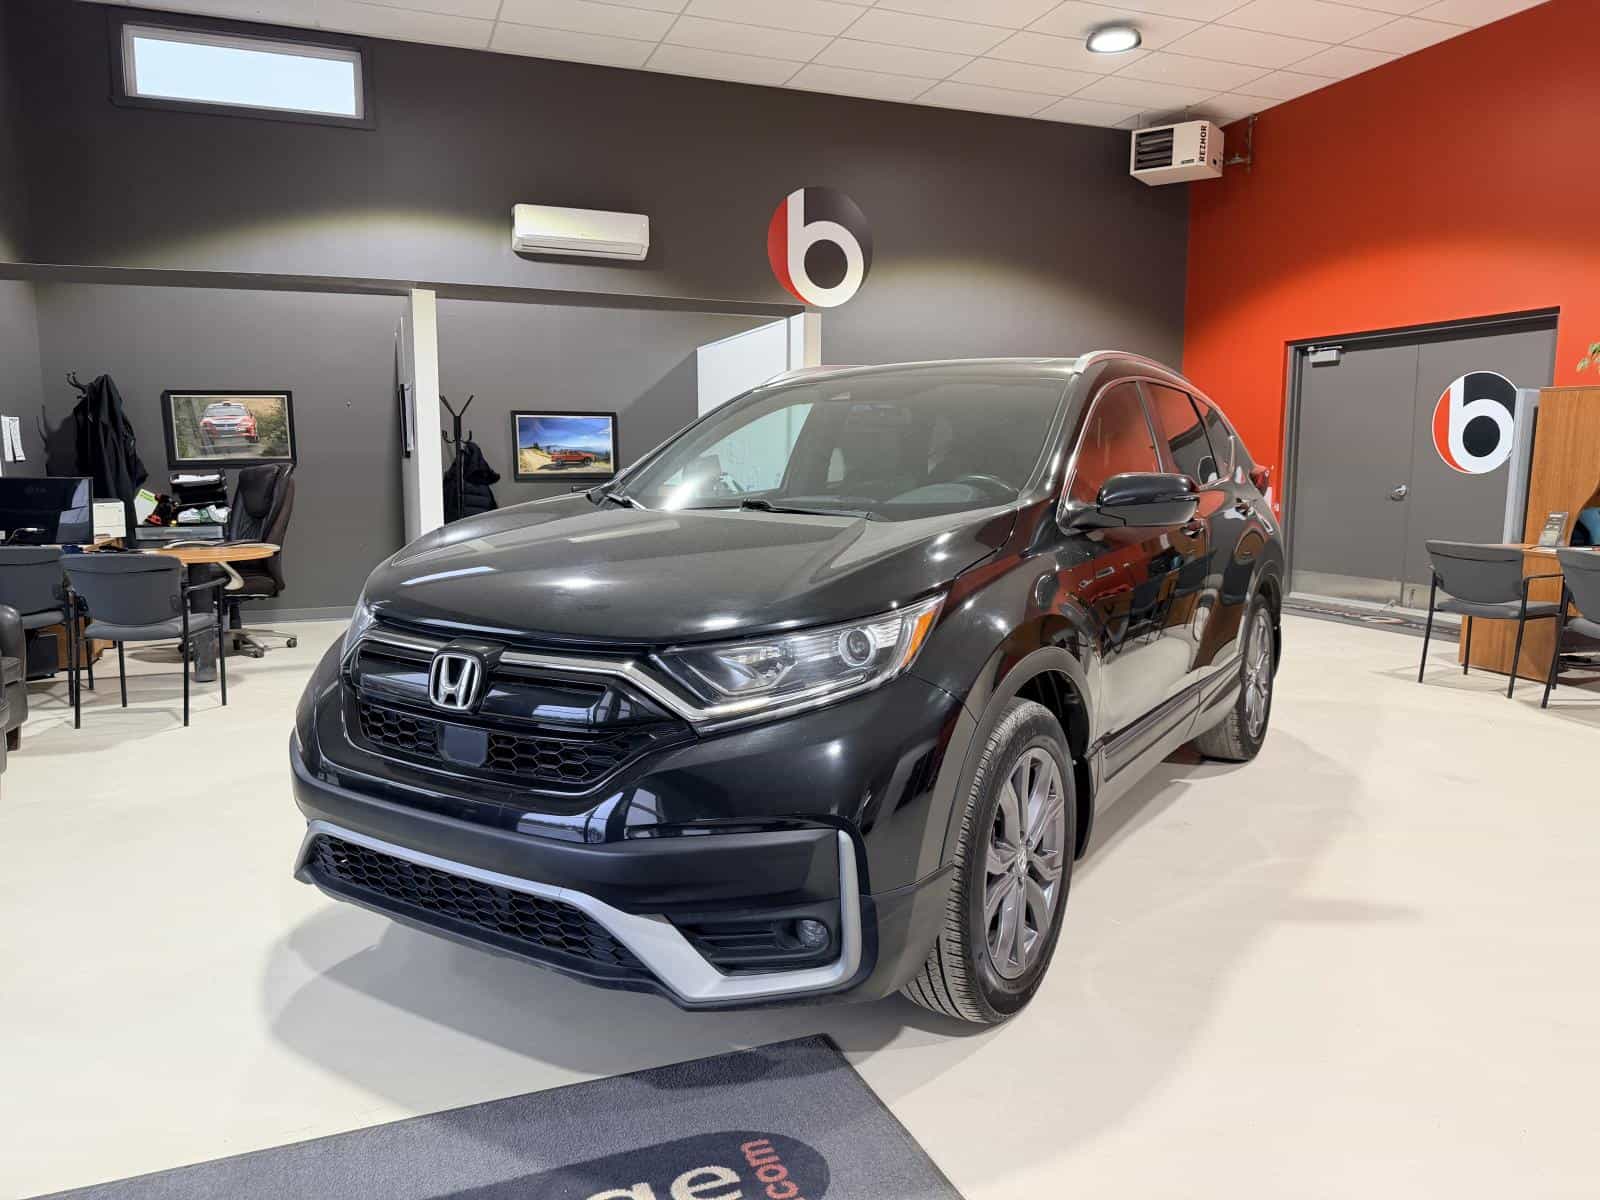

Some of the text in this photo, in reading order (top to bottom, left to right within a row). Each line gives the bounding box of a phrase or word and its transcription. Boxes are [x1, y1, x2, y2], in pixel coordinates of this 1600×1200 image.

[1199, 124, 1207, 162] REZNOR
[787, 187, 864, 308] b
[1448, 376, 1514, 474] b
